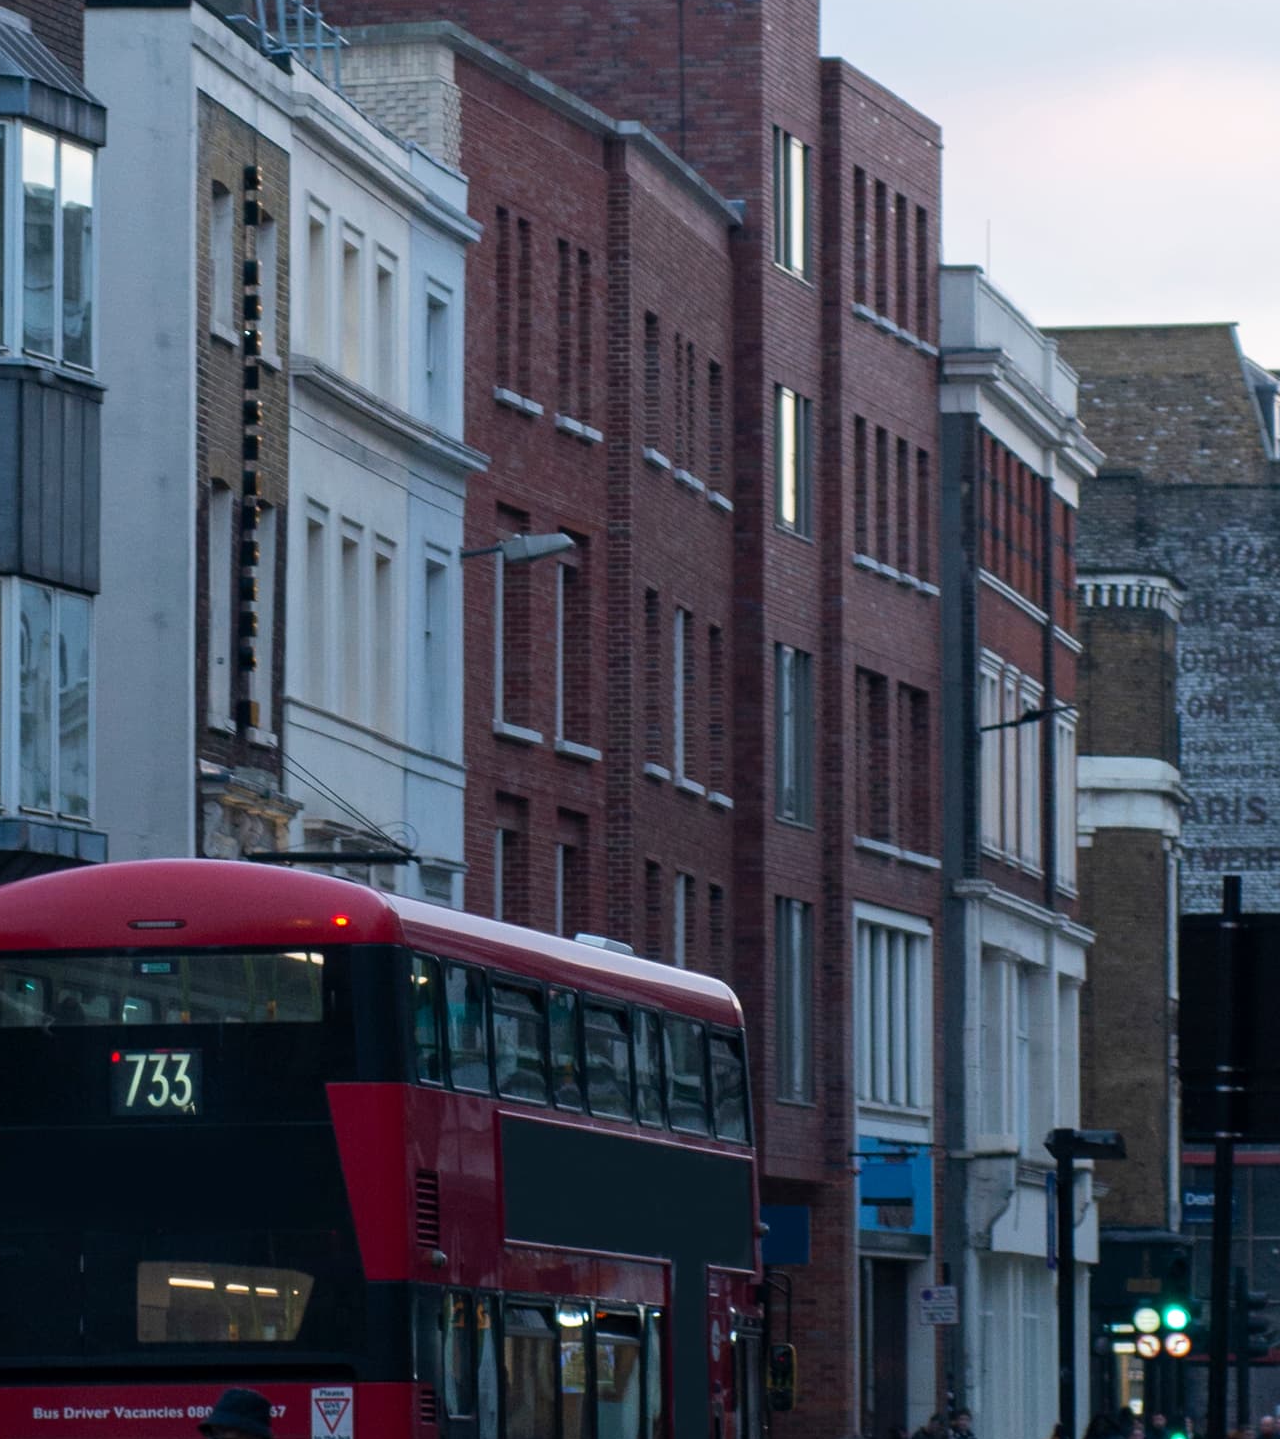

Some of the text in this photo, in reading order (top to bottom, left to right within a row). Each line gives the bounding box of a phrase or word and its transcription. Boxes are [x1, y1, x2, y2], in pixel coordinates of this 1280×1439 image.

[124, 1053, 194, 1108] 733
[32, 1406, 60, 1420] Bus
[63, 1406, 110, 1420] Driver
[112, 1405, 184, 1419] Vacancies
[186, 1405, 213, 1419] 080
